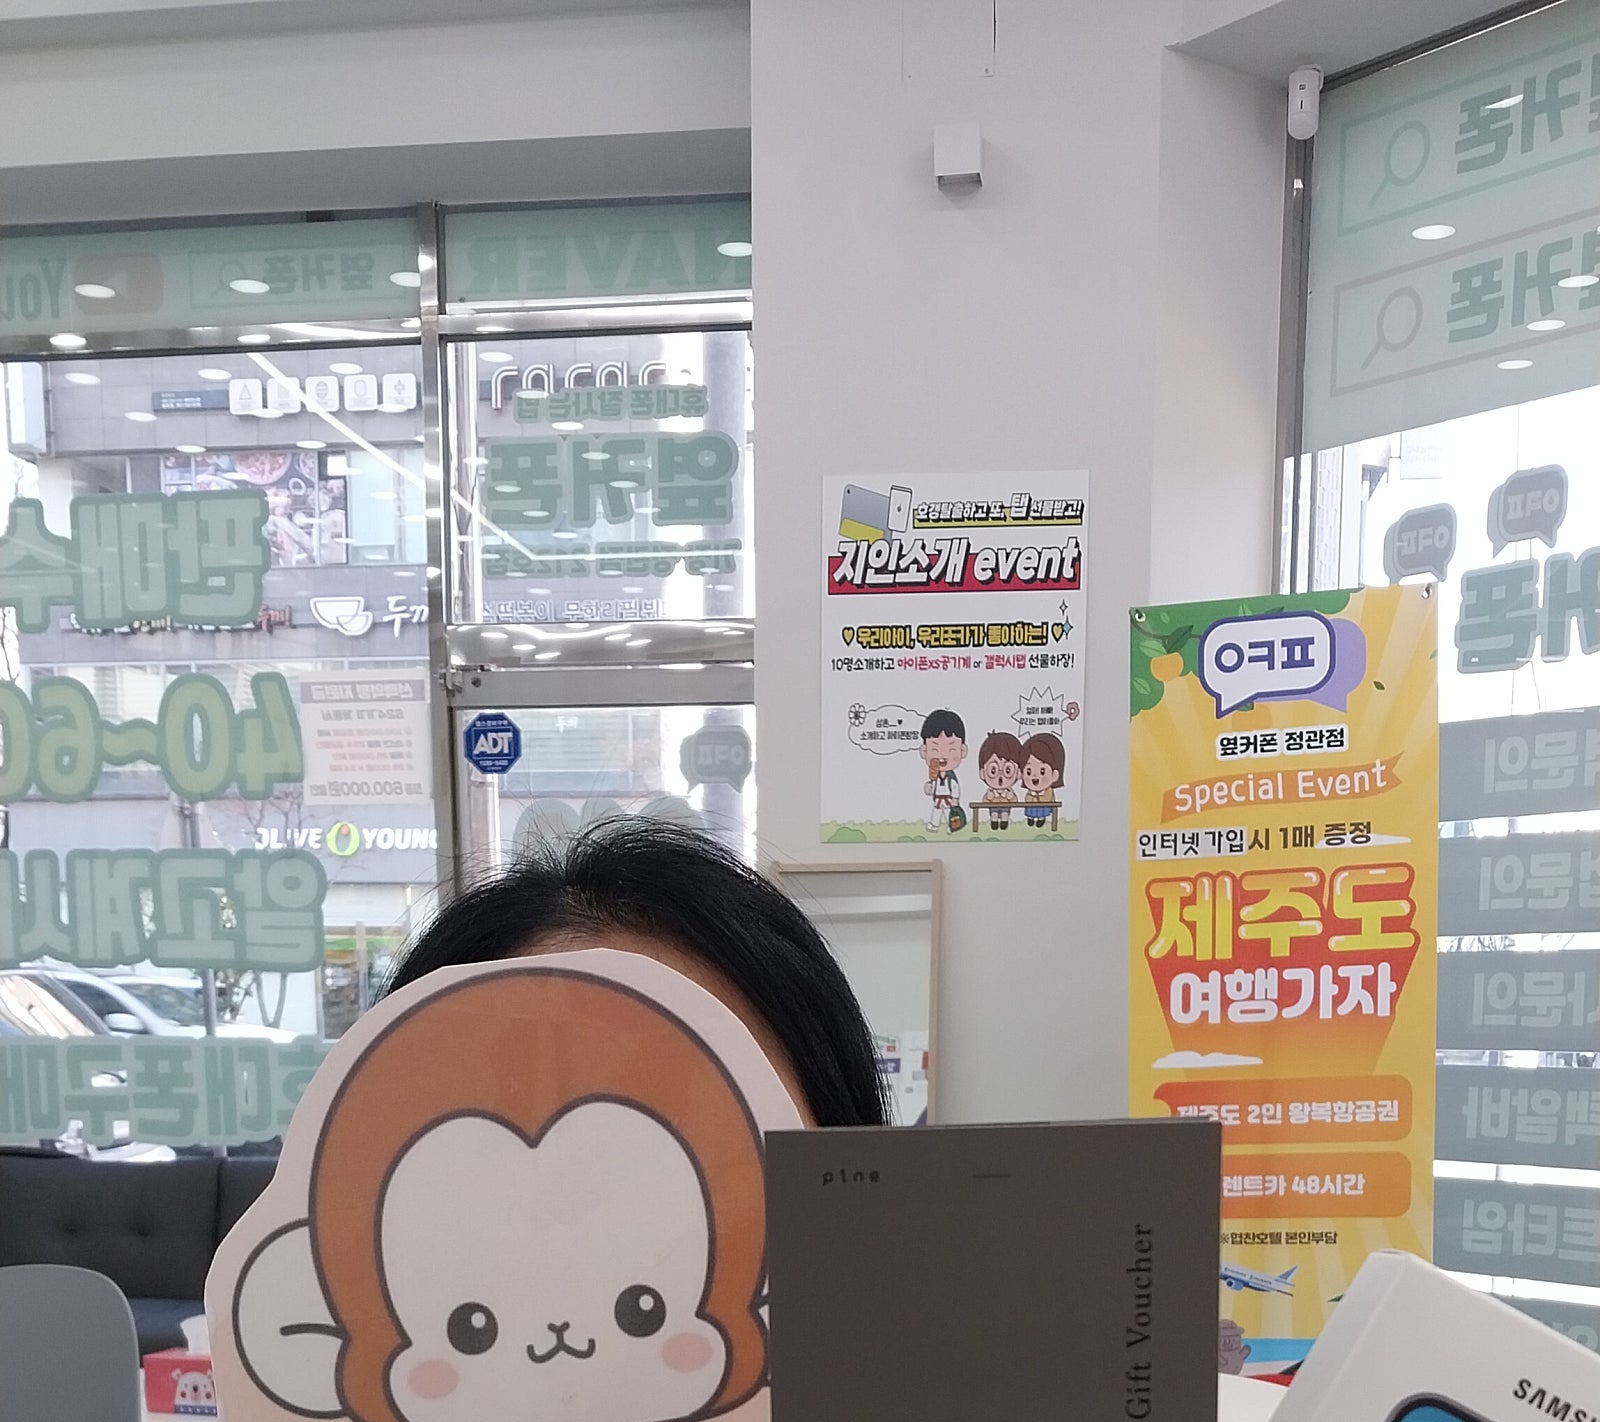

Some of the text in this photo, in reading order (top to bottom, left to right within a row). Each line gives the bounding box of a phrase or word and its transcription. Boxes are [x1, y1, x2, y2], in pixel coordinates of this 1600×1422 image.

[1010, 493, 1032, 519] 탭
[1030, 499, 1084, 520] 선물받고!
[832, 537, 1081, 587] 지인소개 event
[830, 656, 895, 672] 10명소개하고
[984, 654, 1026, 669] 갤럭시탭
[1028, 653, 1075, 669] 선물하장!
[474, 732, 513, 754] ADT
[1219, 728, 1345, 757] 옆커폰 정관점
[1174, 759, 1387, 812] Special Event
[1138, 822, 1372, 858] 인터넷 가입 시 1매 증정
[1146, 863, 1418, 961] 제주도
[1169, 962, 1397, 1024] 여행가자
[1247, 1103, 1283, 1125] 2인
[1288, 1099, 1400, 1124] 왕복항공권
[1222, 1173, 1366, 1198] 렌트카 48시간
[1285, 1231, 1338, 1246] 본인부담
[1124, 1223, 1153, 1421] Gift Voucher
